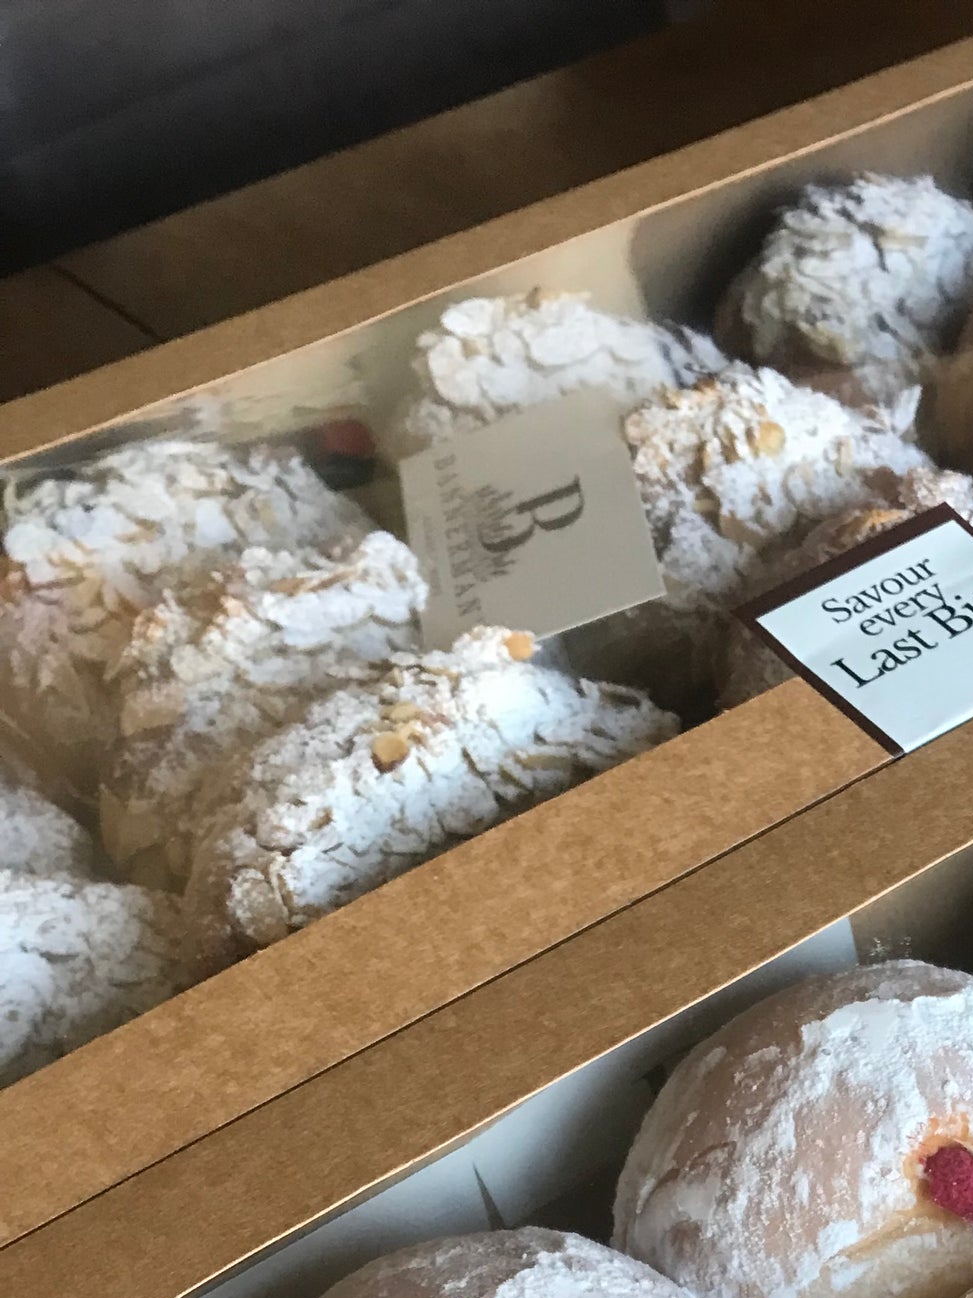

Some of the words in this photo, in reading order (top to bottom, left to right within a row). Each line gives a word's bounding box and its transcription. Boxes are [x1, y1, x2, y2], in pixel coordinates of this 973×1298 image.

[477, 472, 585, 554] B
[821, 558, 936, 624] Savour
[859, 583, 946, 636] every
[830, 629, 939, 689] Last
